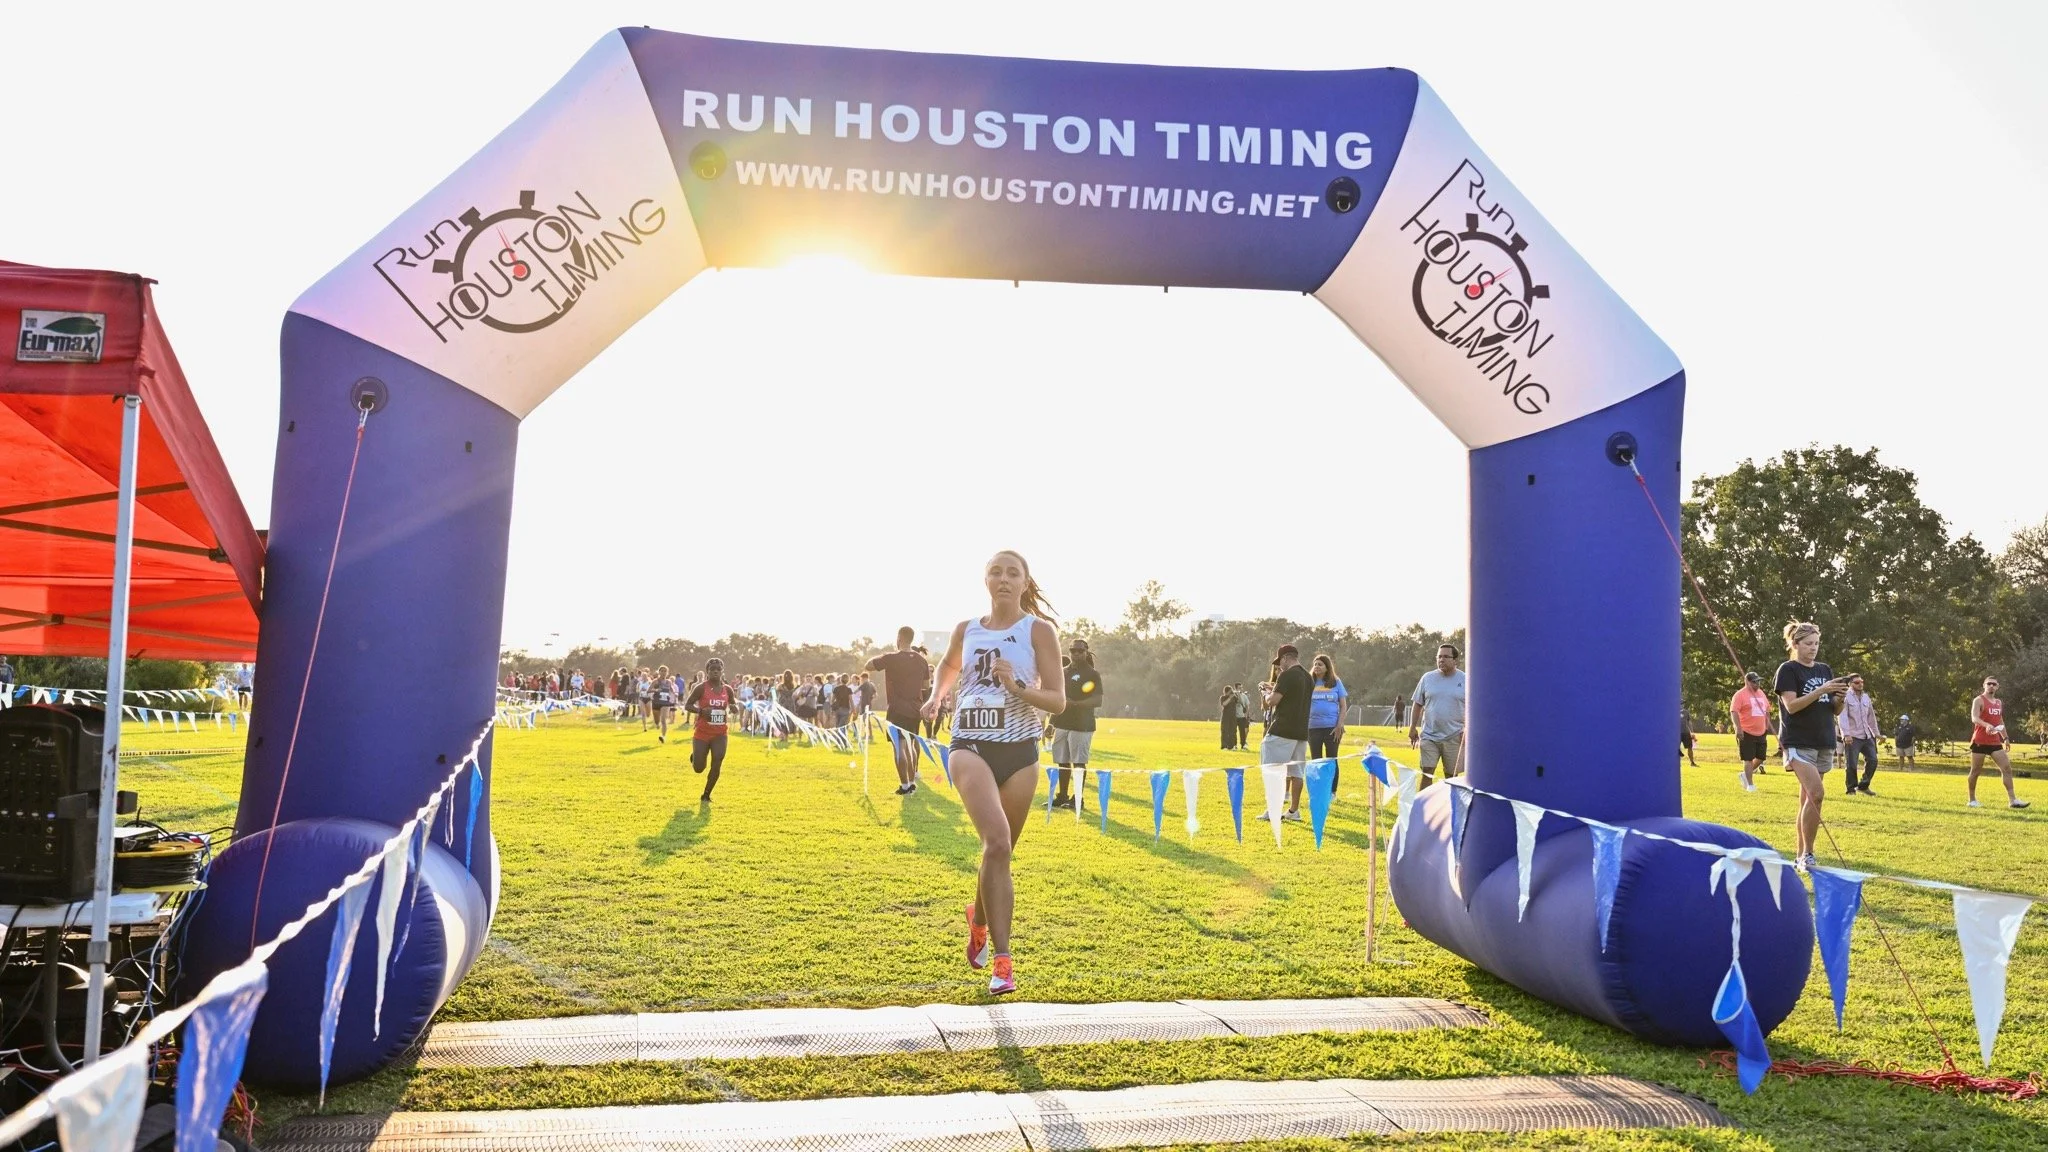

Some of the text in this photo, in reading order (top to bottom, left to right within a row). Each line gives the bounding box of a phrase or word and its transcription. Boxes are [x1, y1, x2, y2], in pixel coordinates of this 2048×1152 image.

[683, 90, 1372, 169] RUN HOUSTON TIMING
[735, 160, 1319, 218] WWW.RUNHOUSTONTIMING.NET
[420, 190, 601, 343] HOUSTON
[530, 198, 666, 312] TIMING
[1400, 216, 1554, 359] HOUSTON
[20, 329, 95, 353] Eurmax
[1434, 300, 1550, 414] TIMING
[709, 699, 726, 707] UST
[965, 708, 998, 728] 1100
[1988, 707, 2002, 716] UST
